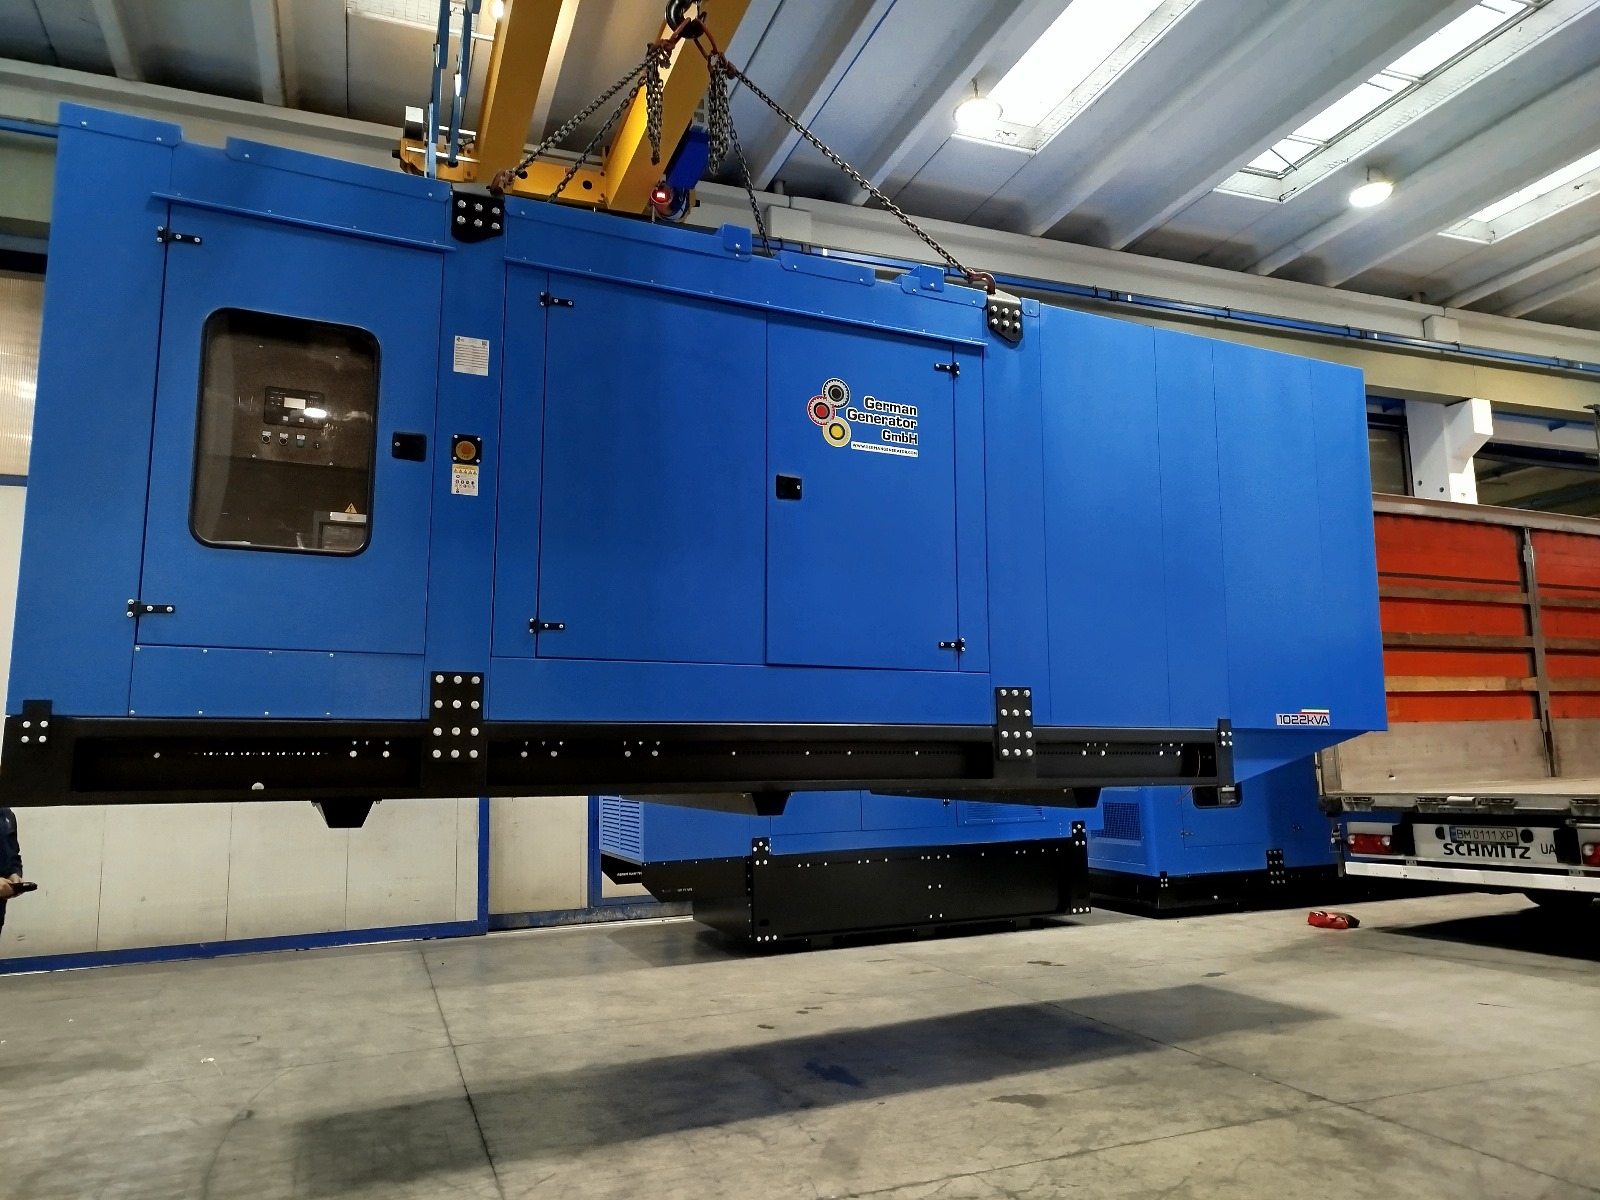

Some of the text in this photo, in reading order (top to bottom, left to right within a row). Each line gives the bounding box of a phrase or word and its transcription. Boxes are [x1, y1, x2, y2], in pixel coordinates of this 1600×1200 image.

[864, 396, 917, 416] German
[846, 408, 917, 429] Generator
[882, 430, 918, 445] GmbH
[1278, 714, 1330, 725] 1022kVA
[1456, 829, 1514, 841] BM 0111 XP
[1443, 843, 1531, 860] SCHMITZ
